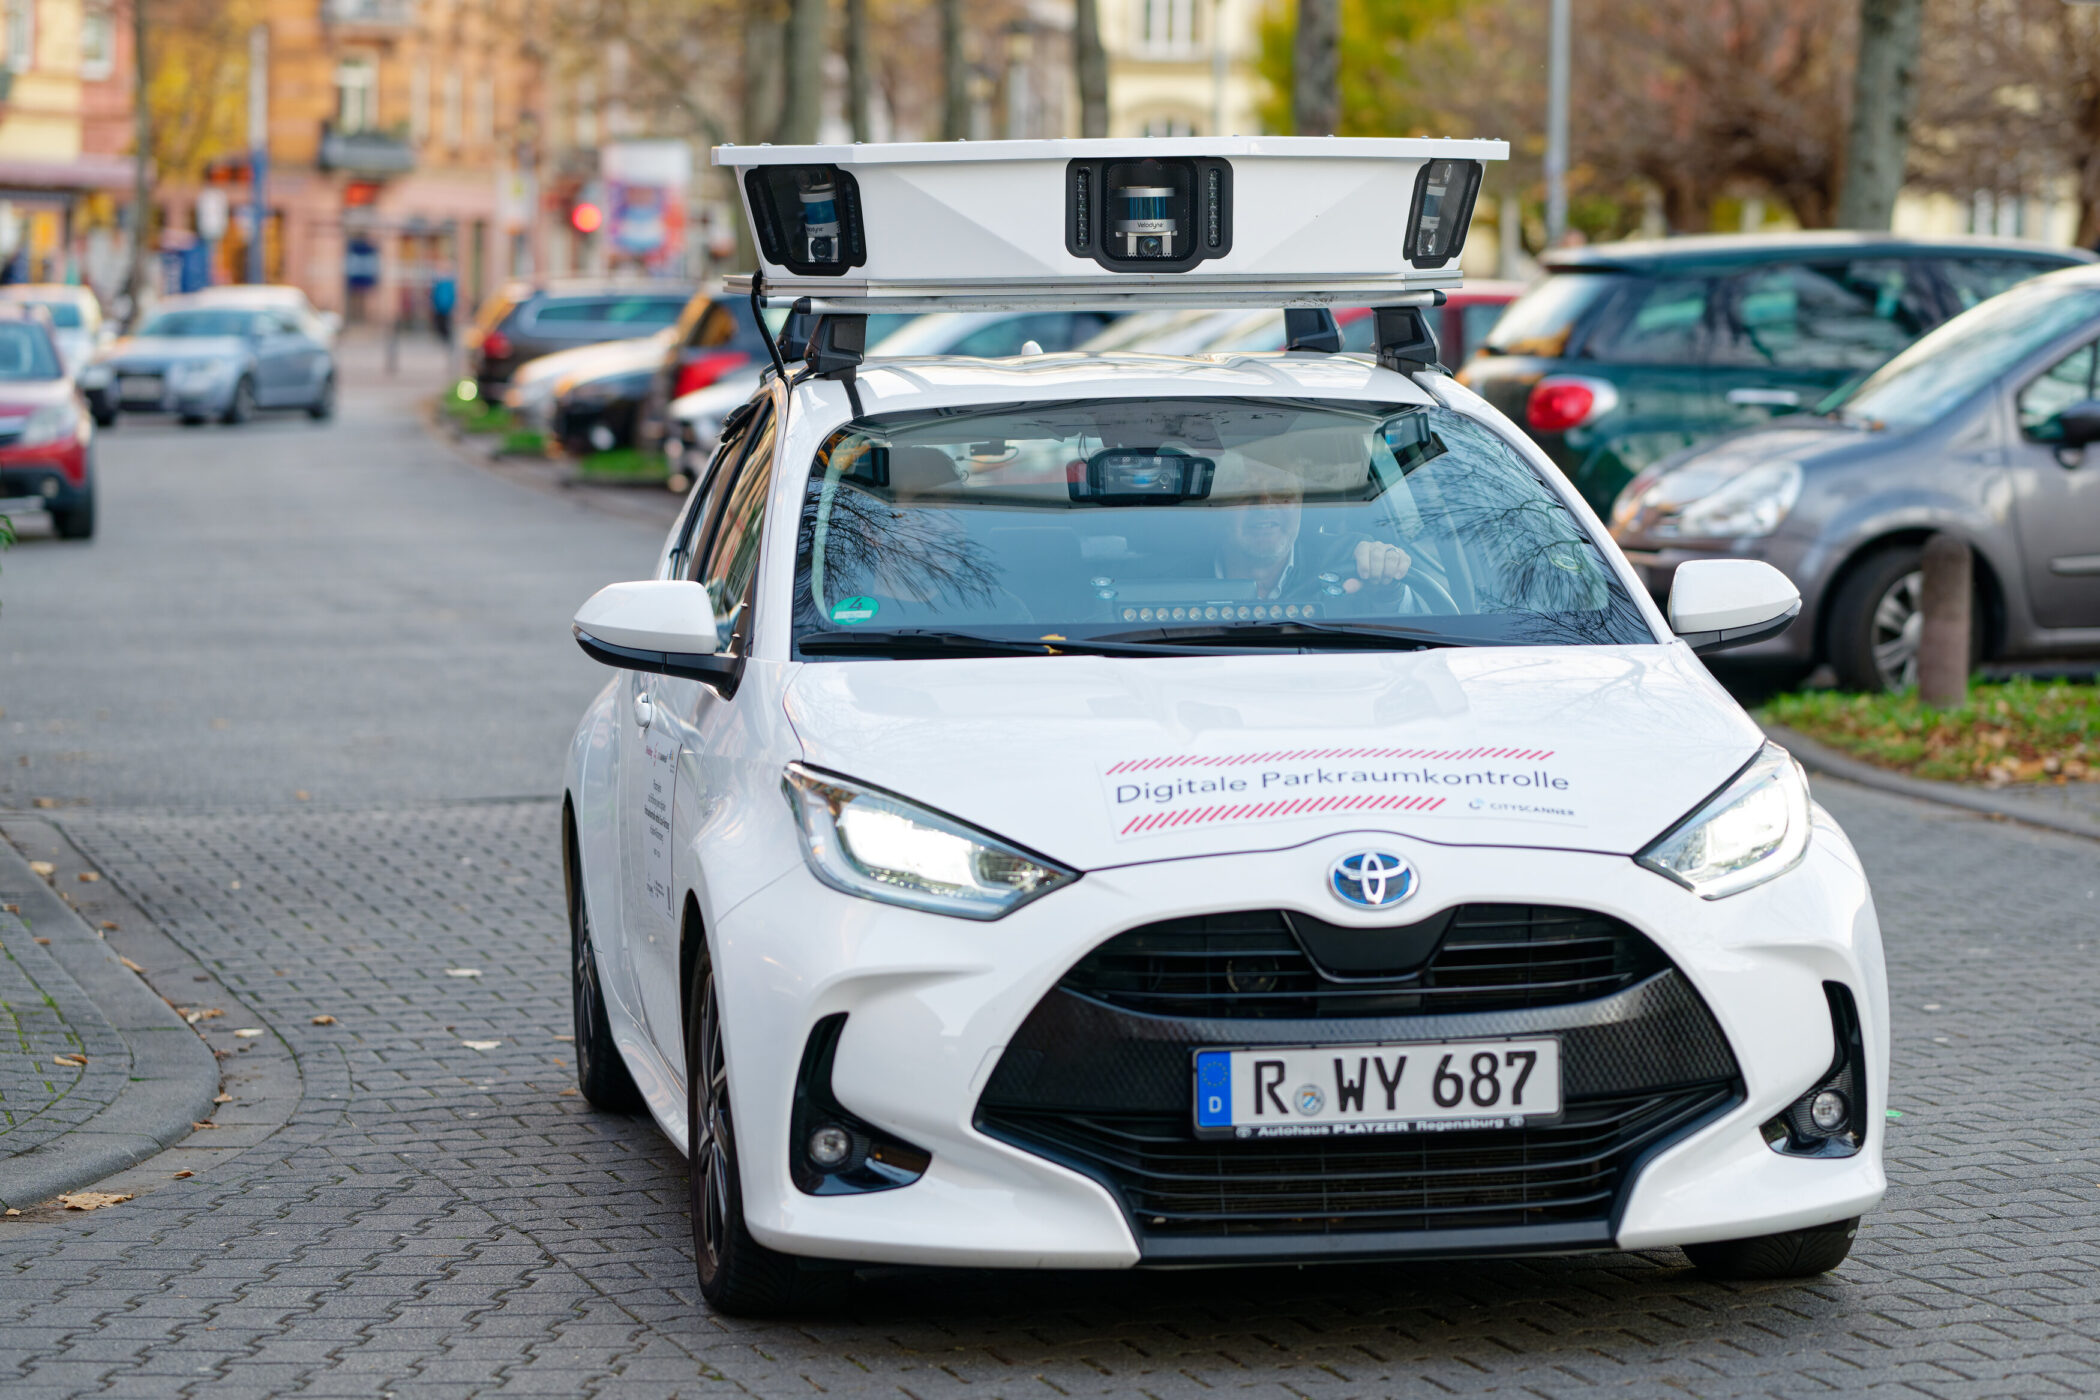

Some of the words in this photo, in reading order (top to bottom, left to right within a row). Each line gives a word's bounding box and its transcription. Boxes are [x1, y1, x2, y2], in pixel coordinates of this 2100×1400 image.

[849, 597, 863, 610] 4
[1117, 776, 1247, 804] Digitale
[1262, 768, 1569, 790] Parkraumkontrolle
[1255, 1061, 1289, 1114] R
[1334, 1056, 1407, 1112] WY
[1432, 1051, 1537, 1108] 687
[1208, 1096, 1222, 1113] D
[1258, 1126, 1329, 1138] Autohaus
[1416, 1118, 1504, 1131] Regensburg
